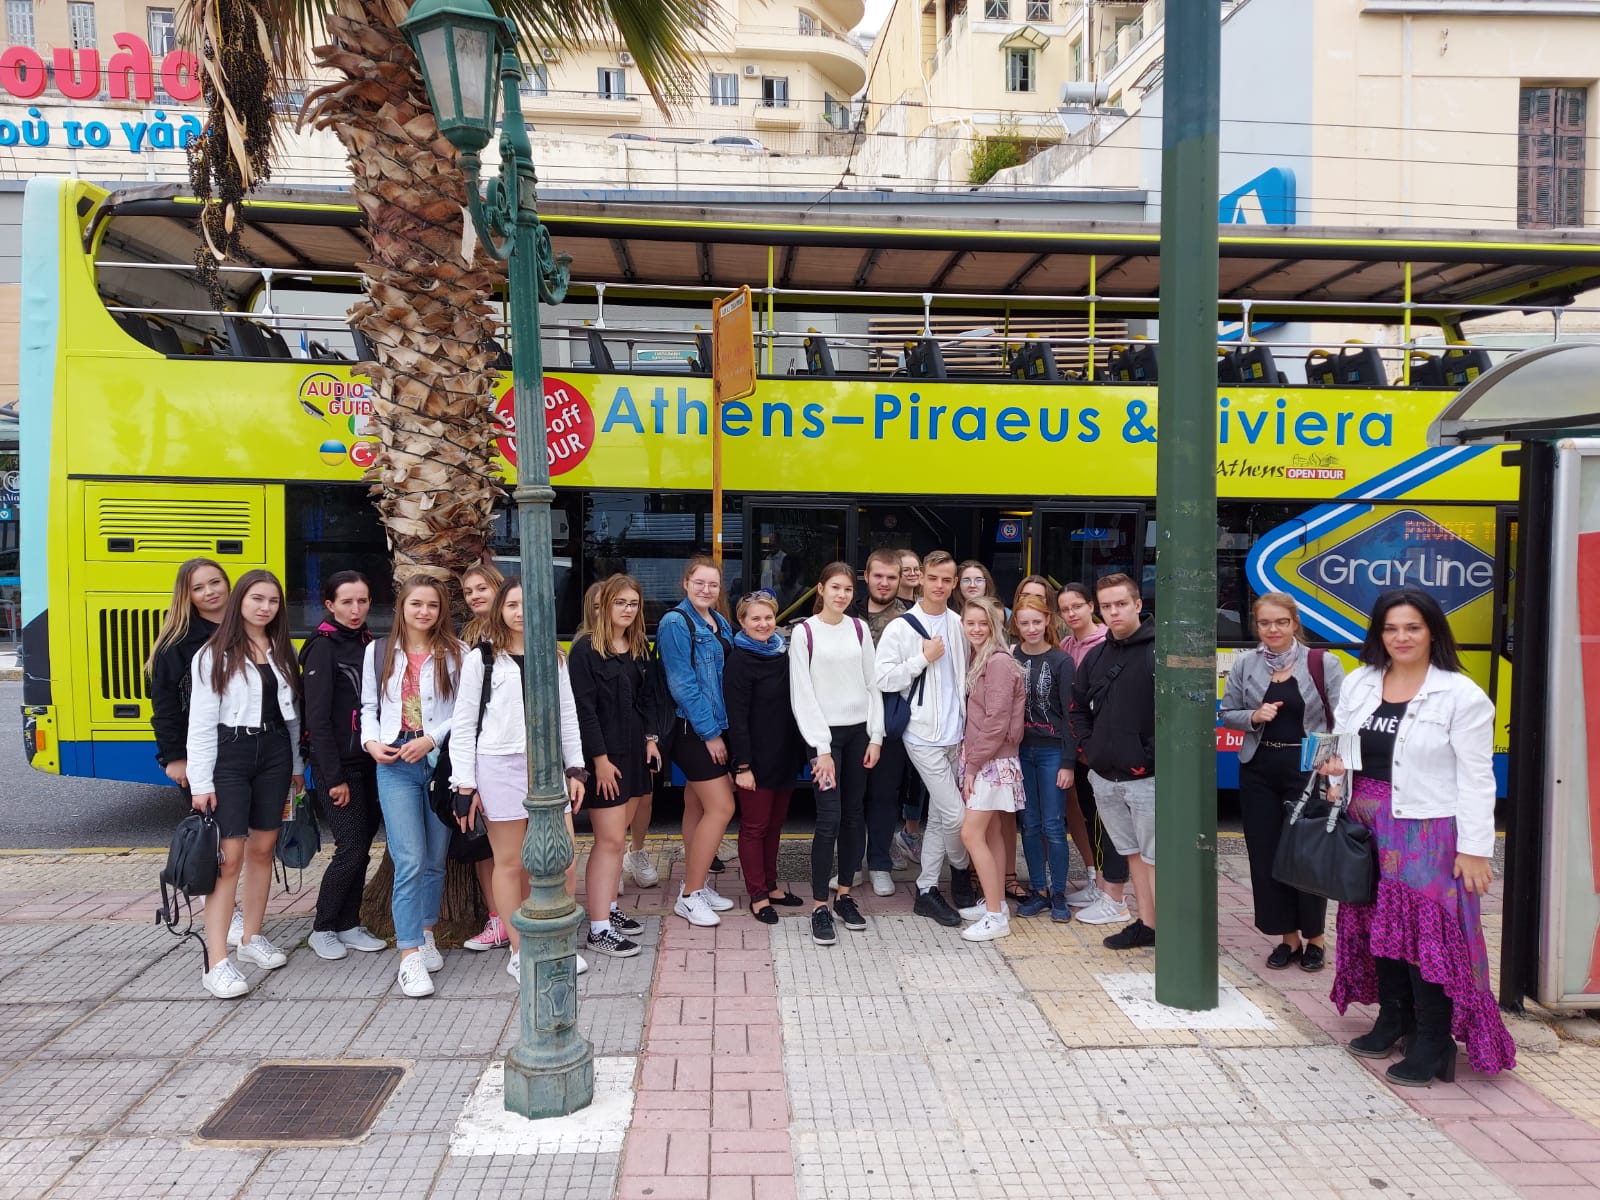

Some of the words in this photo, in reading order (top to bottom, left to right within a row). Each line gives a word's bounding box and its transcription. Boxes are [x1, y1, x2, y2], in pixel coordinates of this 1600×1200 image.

[63, 121, 111, 149] το
[120, 109, 206, 154] γάλ
[306, 381, 364, 397] AUDIO
[328, 400, 373, 416] GUID
[1122, 399, 1158, 443] &
[1220, 397, 1393, 447] iviera
[547, 433, 586, 465] OUR
[1216, 458, 1284, 478] Athens
[1287, 469, 1315, 479] OPEN
[1317, 469, 1344, 479] TOUR
